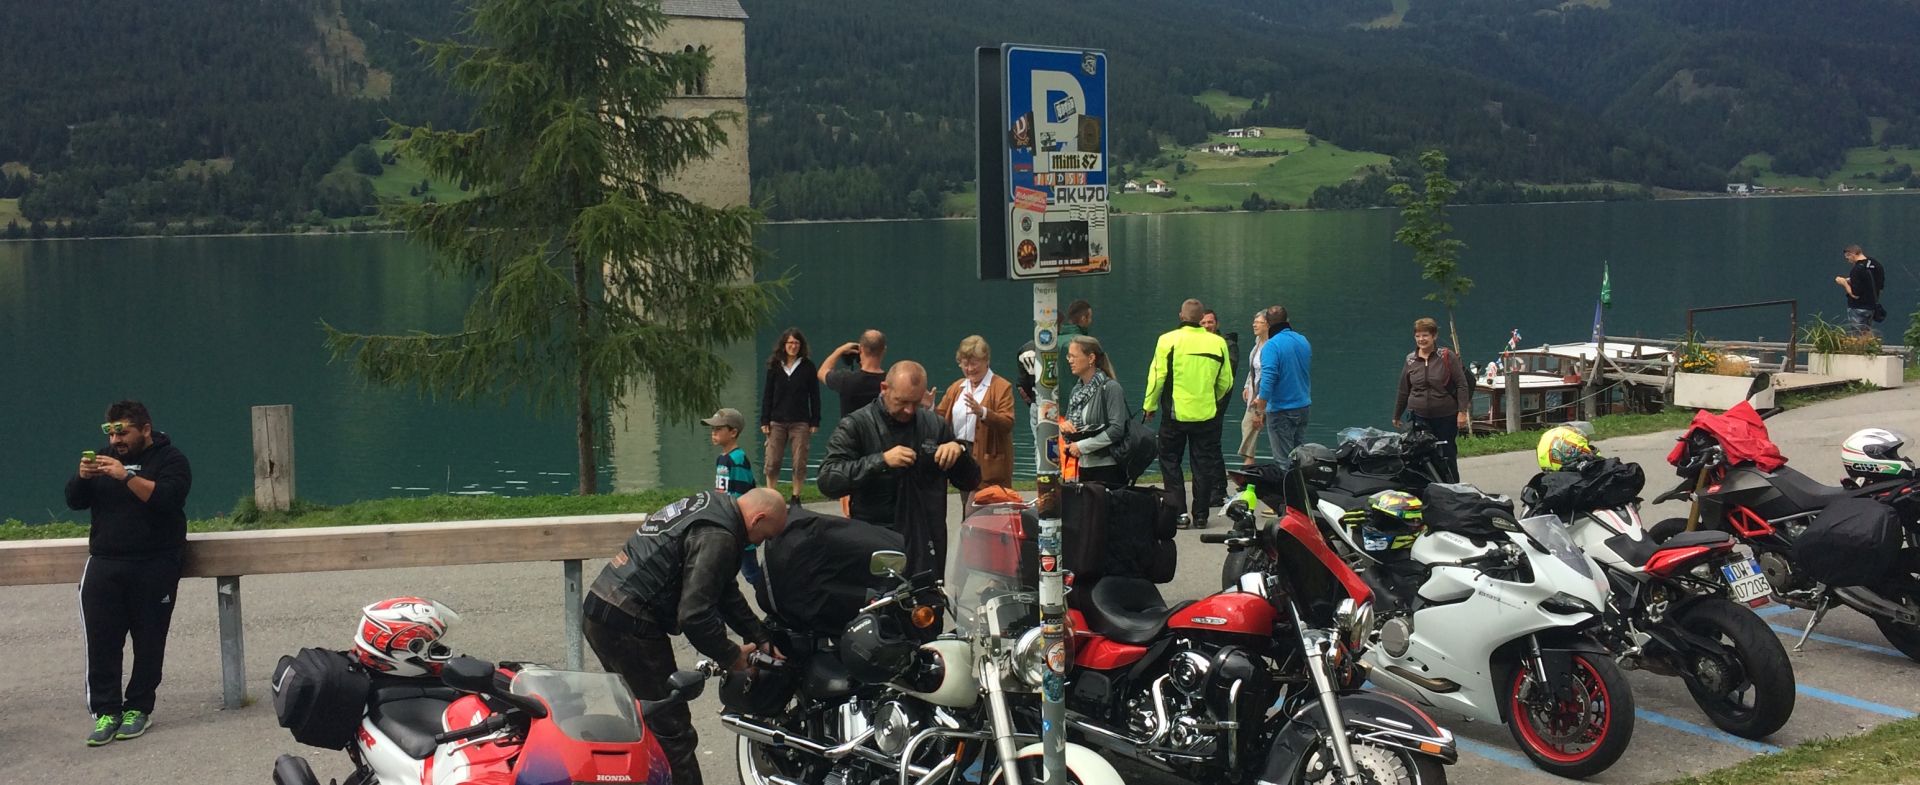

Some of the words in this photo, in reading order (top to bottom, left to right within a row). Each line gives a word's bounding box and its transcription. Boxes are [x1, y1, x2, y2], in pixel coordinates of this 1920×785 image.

[1031, 69, 1086, 173] P
[1082, 153, 1098, 170] 87
[1057, 186, 1106, 204] AK470
[1853, 462, 1880, 472] GIVI
[1735, 577, 1770, 599] 07203
